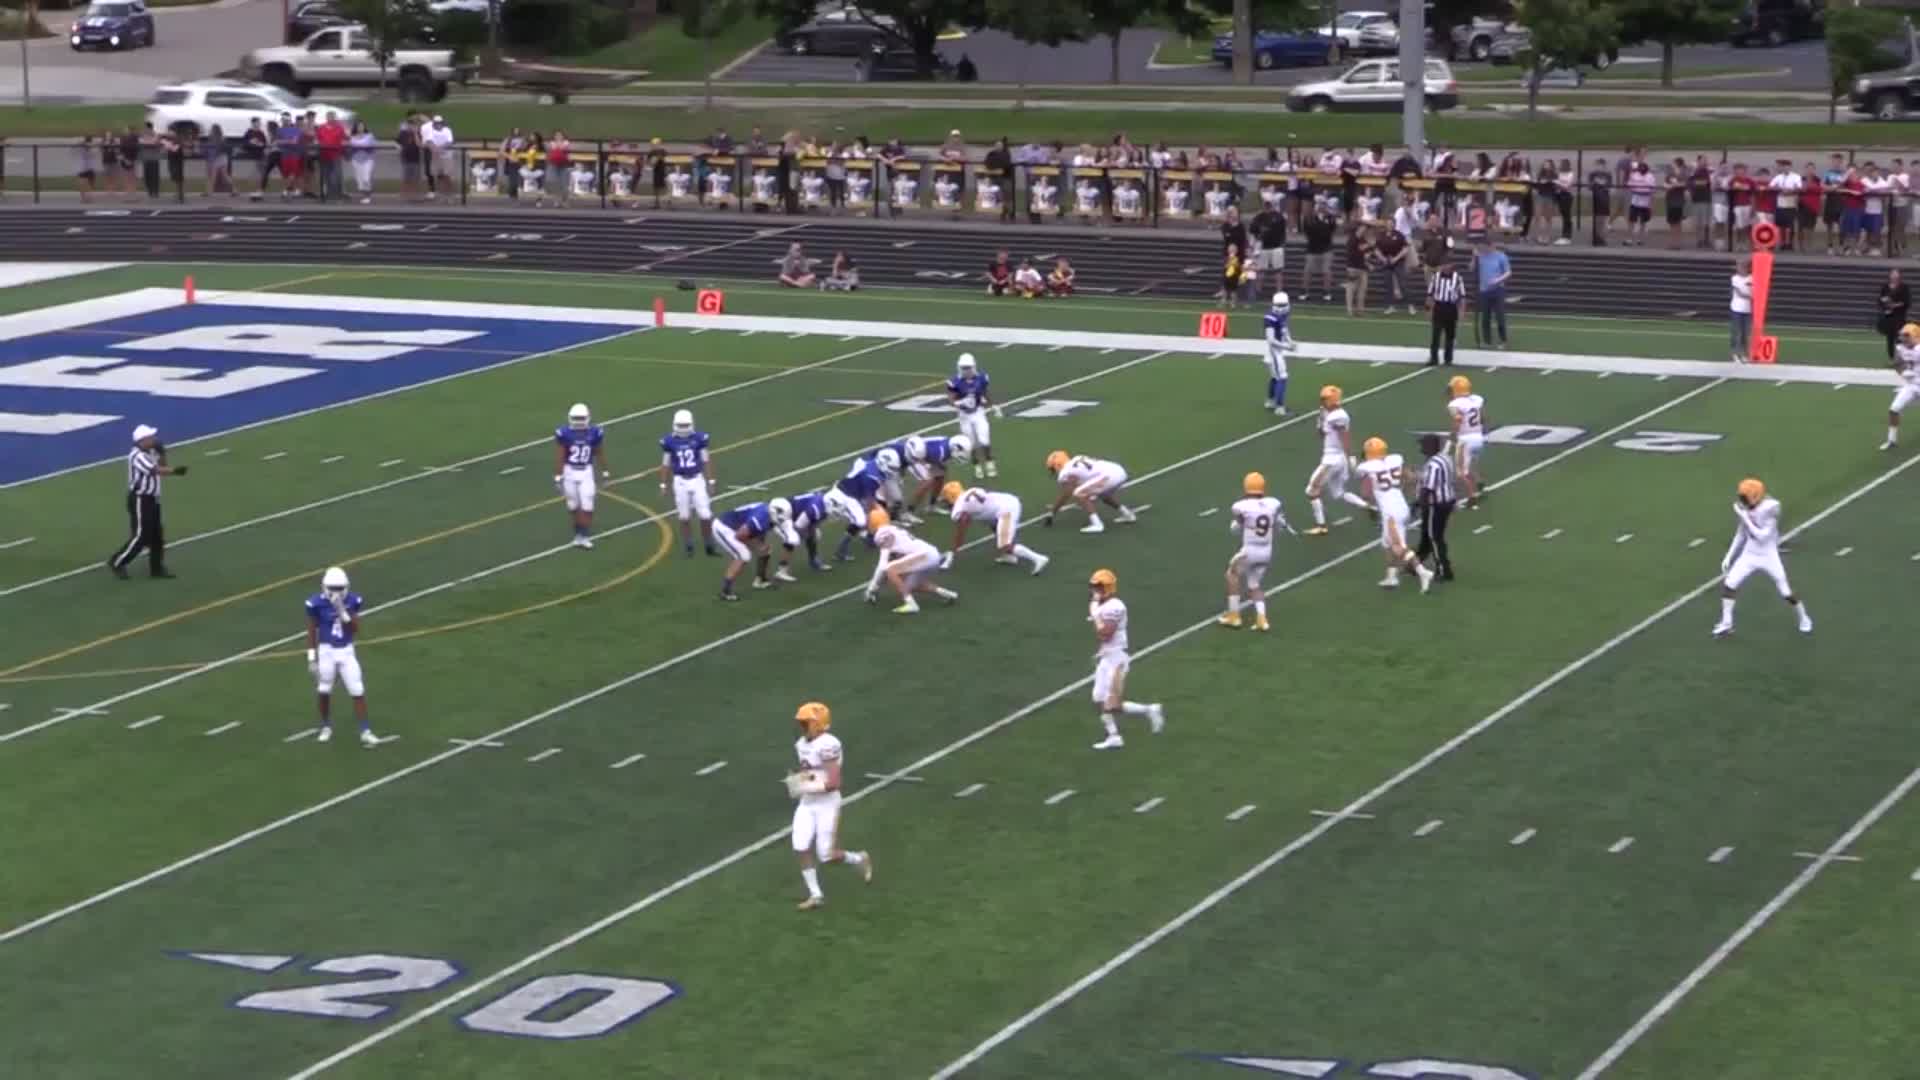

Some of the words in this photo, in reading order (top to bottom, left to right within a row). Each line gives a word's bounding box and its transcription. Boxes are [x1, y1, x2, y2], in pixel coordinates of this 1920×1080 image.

[700, 293, 717, 313] G
[1204, 315, 1222, 336] 10
[569, 445, 592, 463] 20
[676, 450, 696, 467] 12
[1375, 469, 1402, 492] 55
[234, 953, 678, 1038] 20
